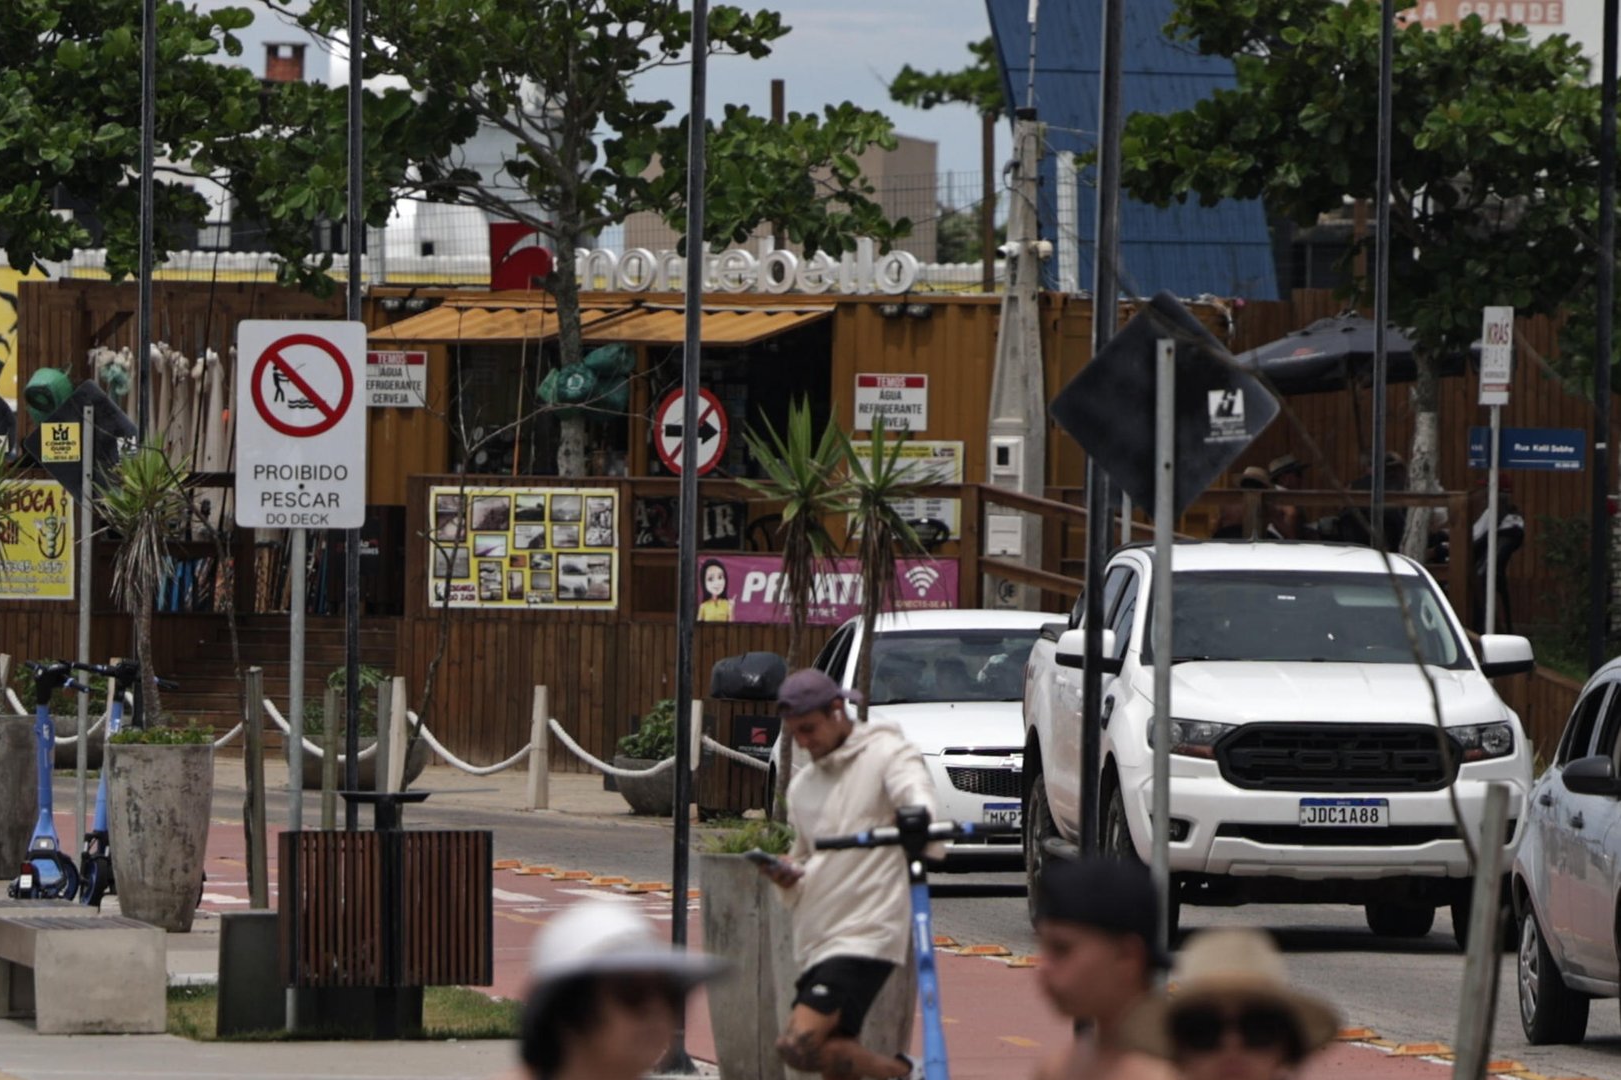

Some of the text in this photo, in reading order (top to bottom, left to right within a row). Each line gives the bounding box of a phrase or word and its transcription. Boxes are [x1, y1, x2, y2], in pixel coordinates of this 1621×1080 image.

[377, 353, 407, 364] TEMOS
[366, 380, 422, 391] EFRIGERANTE
[876, 376, 906, 388] TEMOS
[372, 393, 409, 404] CERVEJA
[879, 388, 902, 401] ÁGUA
[1514, 443, 1530, 452] Rua
[253, 465, 348, 481] PROIBIDO
[260, 492, 340, 508] PESCAR
[266, 513, 329, 525] DO DECK
[1307, 807, 1379, 824] JDC1A88
